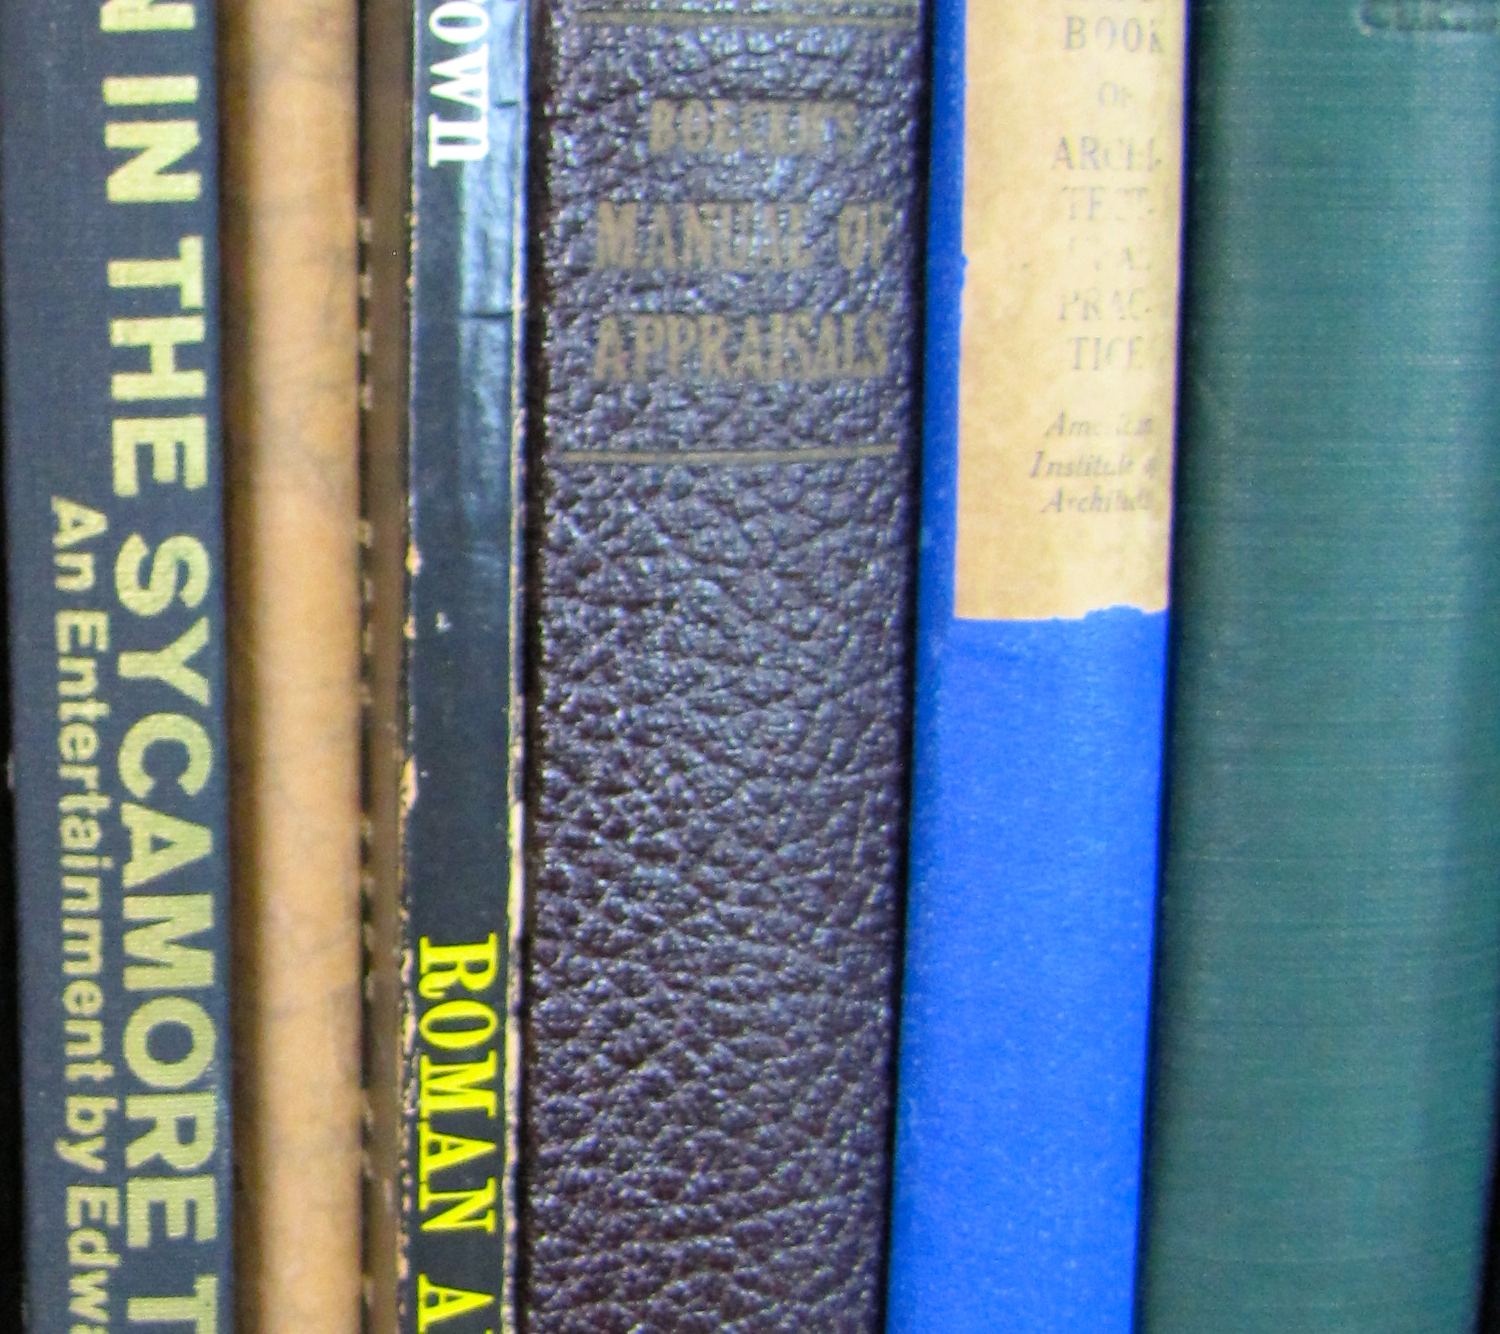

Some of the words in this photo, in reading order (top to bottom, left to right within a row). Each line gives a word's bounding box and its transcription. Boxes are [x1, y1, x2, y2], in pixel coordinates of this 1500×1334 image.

[103, 75, 202, 204] IN
[108, 235, 208, 498] THE
[51, 495, 109, 593] An
[56, 609, 115, 1082] Entertainment
[114, 532, 218, 1249] SYCAMORE
[56, 1094, 117, 1173] by
[418, 931, 499, 1234] ROMAN
